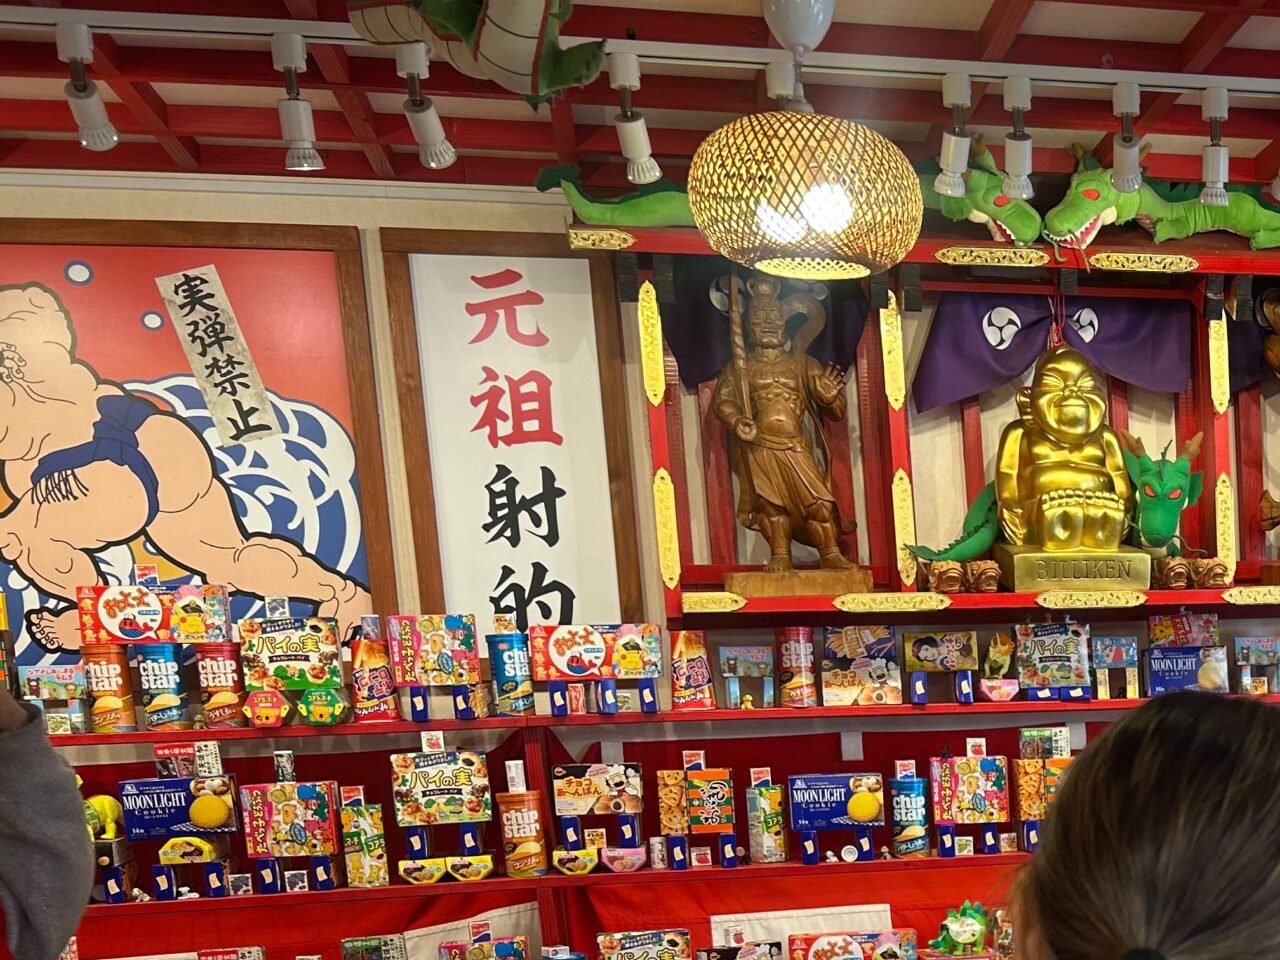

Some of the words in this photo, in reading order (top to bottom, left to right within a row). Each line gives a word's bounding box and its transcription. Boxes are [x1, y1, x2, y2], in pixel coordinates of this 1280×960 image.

[172, 273, 272, 442] 実弾禁止
[467, 268, 577, 632] 元祖射的
[256, 633, 321, 654] パイの実
[401, 619, 418, 682] たべっ子どうぶつ
[780, 640, 814, 657] chip
[1030, 637, 1079, 655] パイの実
[503, 649, 528, 664] chi
[781, 654, 814, 668] star
[1151, 657, 1197, 672] MOONLIGHT
[139, 659, 179, 677] chip
[198, 657, 237, 676] chip
[504, 662, 530, 677] sta
[831, 669, 857, 681] チョコ
[140, 672, 180, 689] star
[199, 670, 239, 688] star
[409, 768, 473, 790] パイの実
[564, 775, 593, 788] チョコ
[122, 792, 186, 811] MOONLIGHT
[793, 788, 847, 804] MOONLIGHT
[892, 793, 926, 811] chip
[134, 808, 177, 816] Cookie
[802, 801, 837, 809] Cookie
[251, 789, 268, 854] たべっ子どうぶつ
[502, 808, 538, 826] chip
[893, 807, 926, 823] star
[504, 822, 540, 838] star
[369, 839, 386, 851] コアラ
